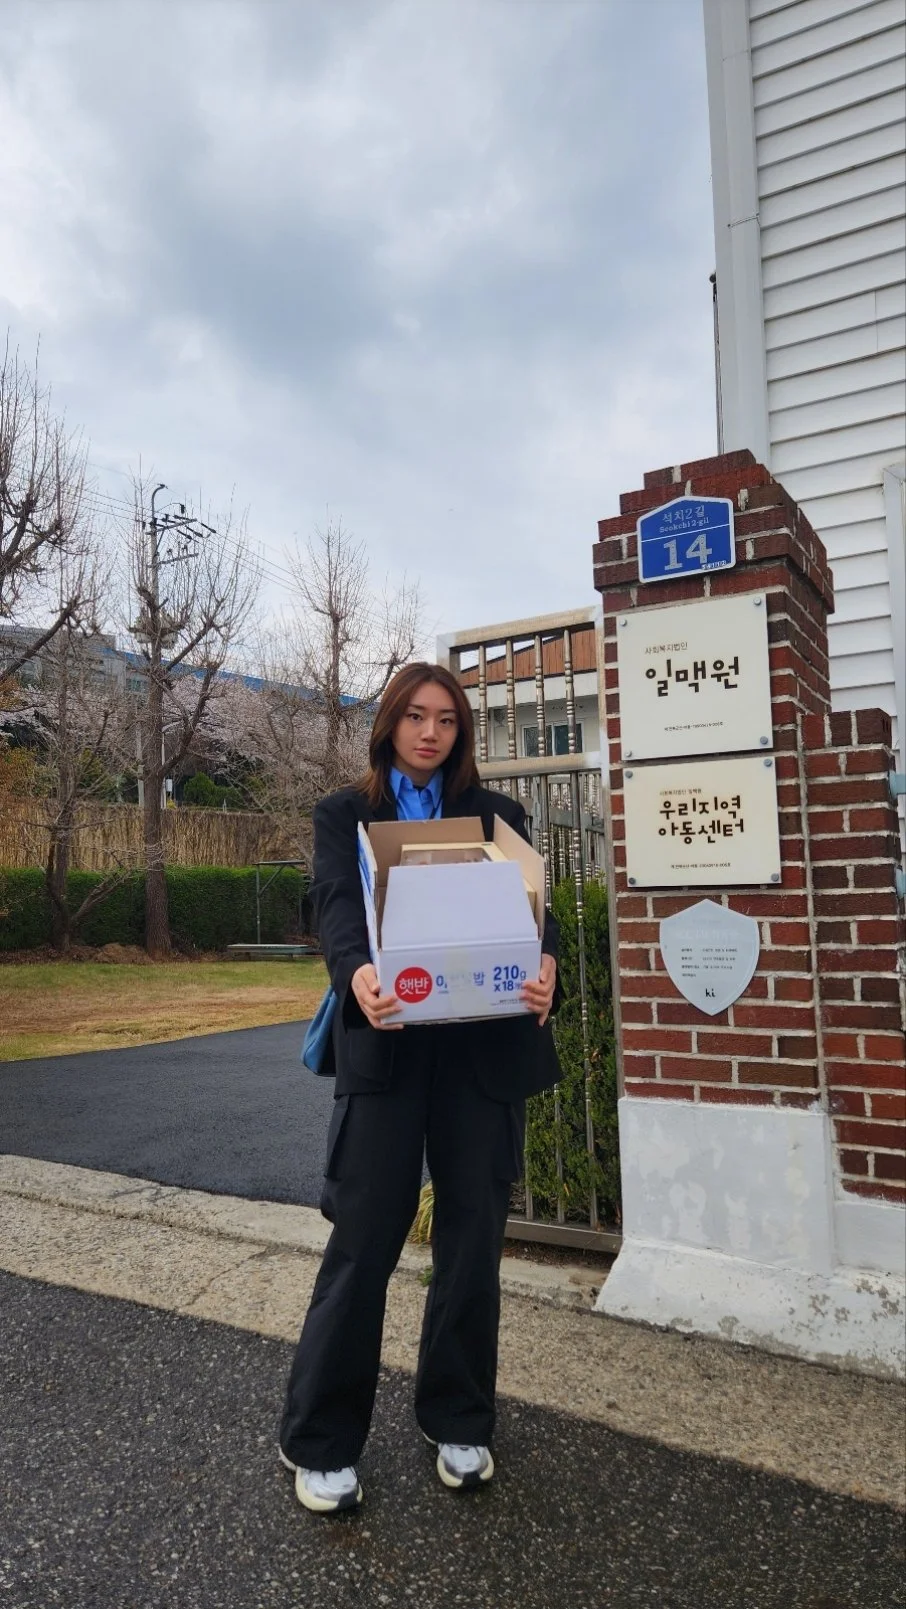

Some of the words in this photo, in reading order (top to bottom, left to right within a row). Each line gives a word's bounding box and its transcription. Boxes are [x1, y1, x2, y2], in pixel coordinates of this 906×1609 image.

[662, 505, 705, 523] 석치2길
[663, 533, 713, 571] 14
[644, 641, 689, 655] 사회복지법인
[645, 656, 740, 698] 일맥원
[659, 795, 742, 820] 우리지역
[658, 818, 745, 845] 아동센터
[493, 965, 527, 981] 210g
[399, 977, 429, 996] 햇반
